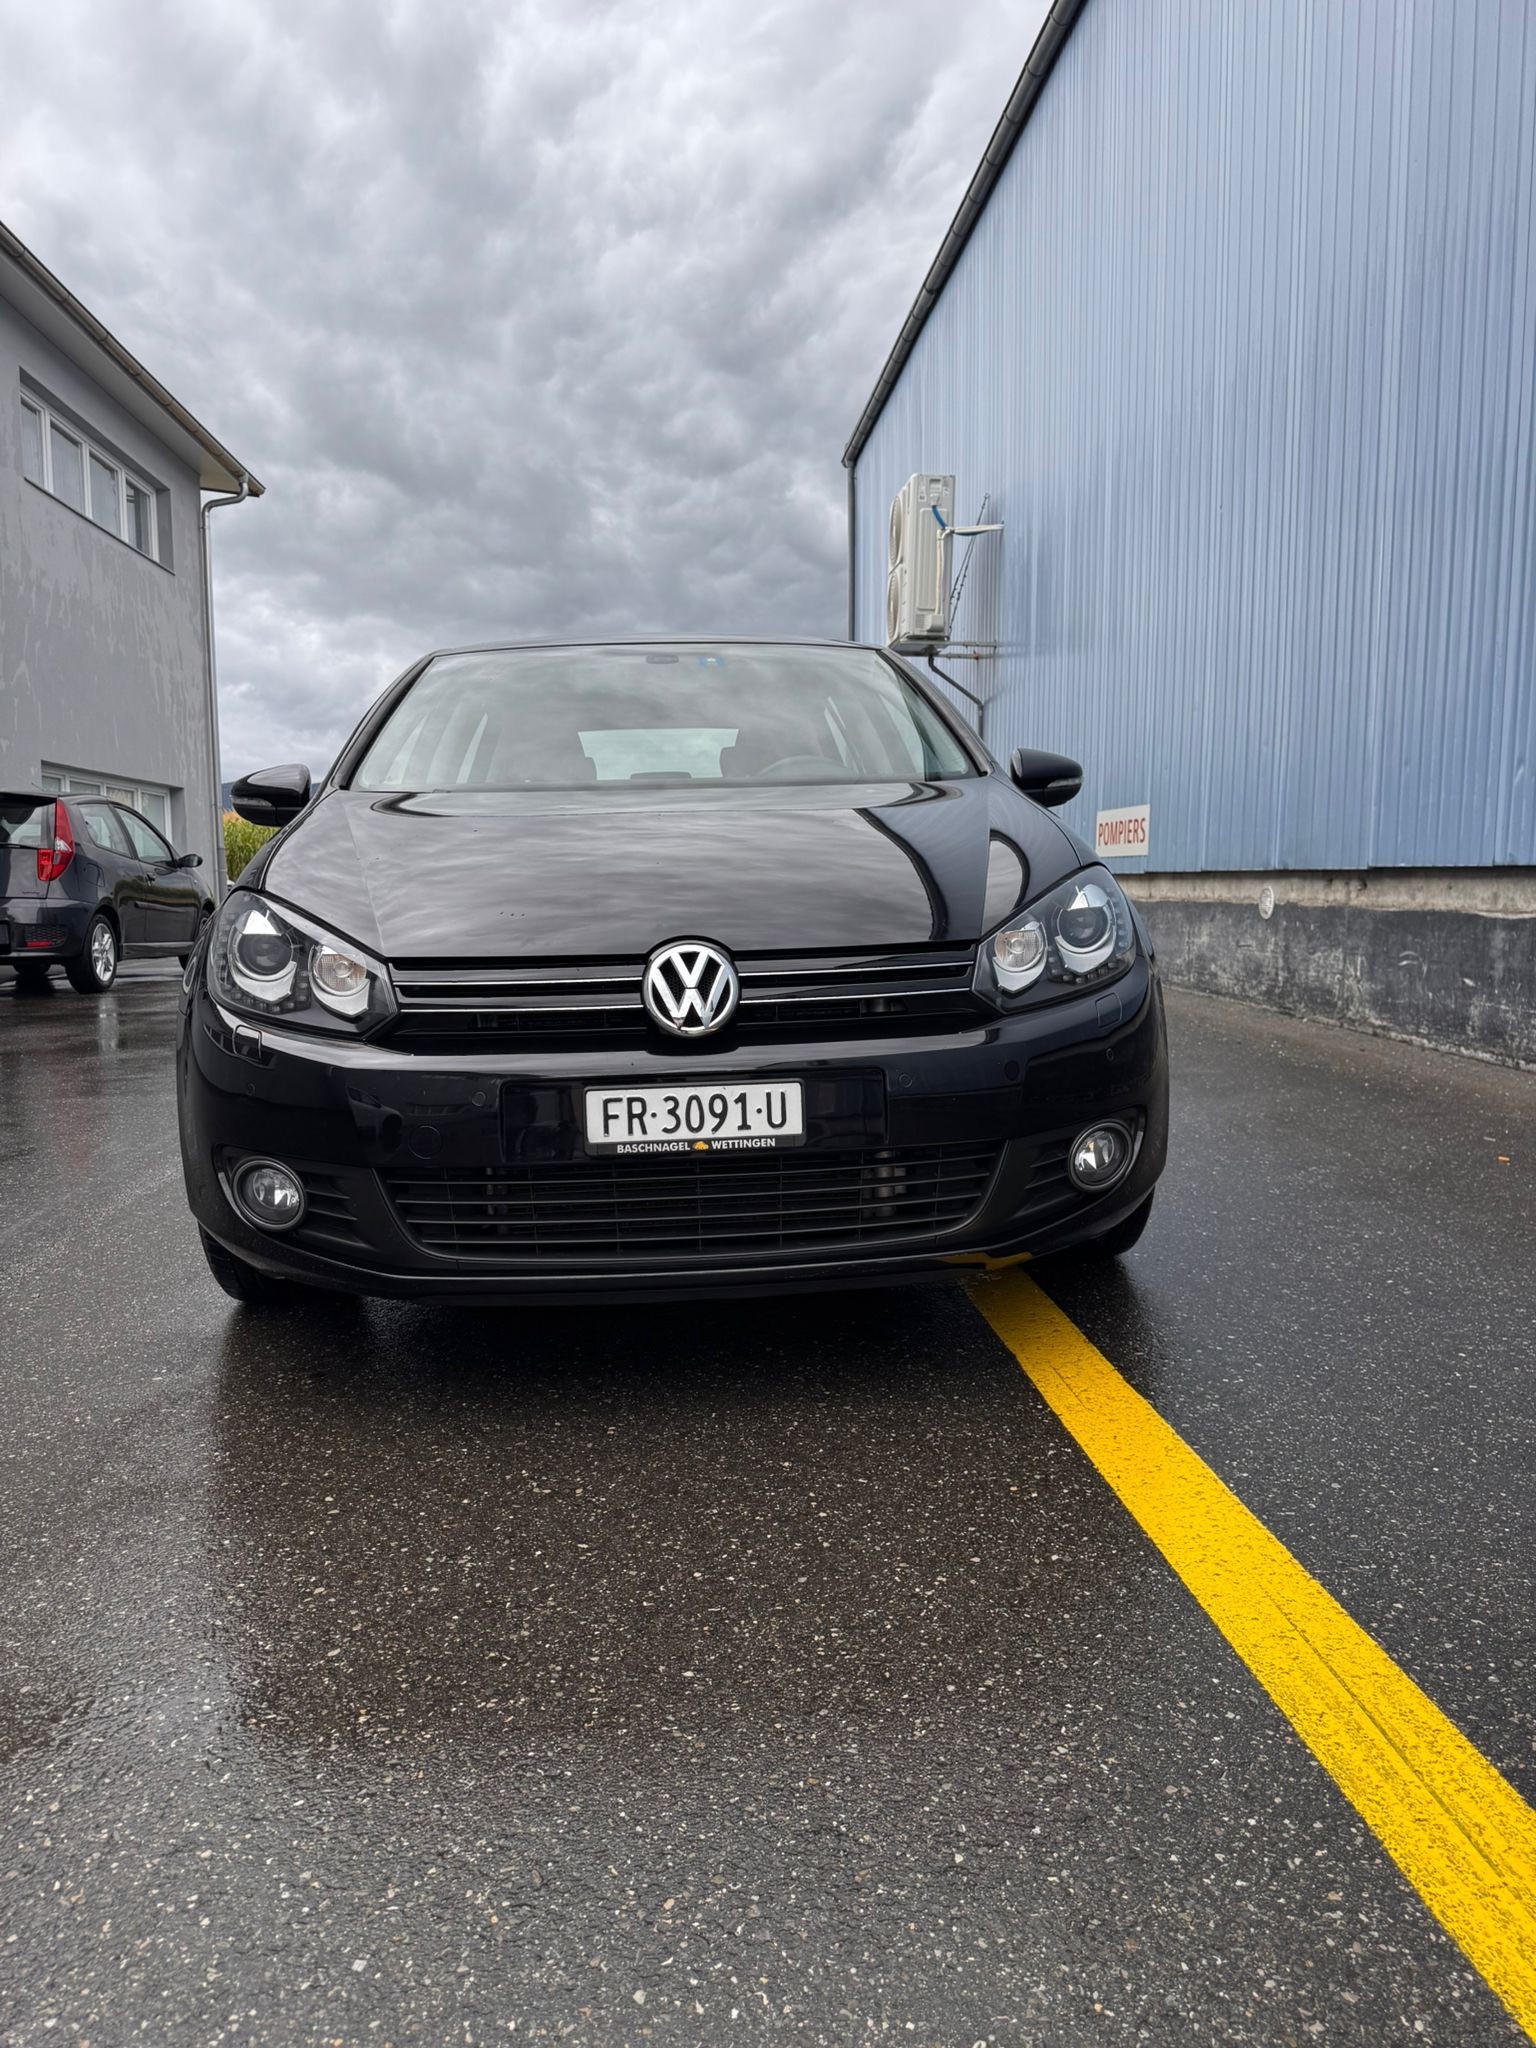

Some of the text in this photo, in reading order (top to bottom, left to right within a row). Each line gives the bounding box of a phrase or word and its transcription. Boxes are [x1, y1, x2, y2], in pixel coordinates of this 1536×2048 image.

[1098, 817, 1146, 846] POMPIERS
[648, 944, 735, 1030] VW
[616, 1137, 776, 1154] BASCHNAGEL WETTINGEN
